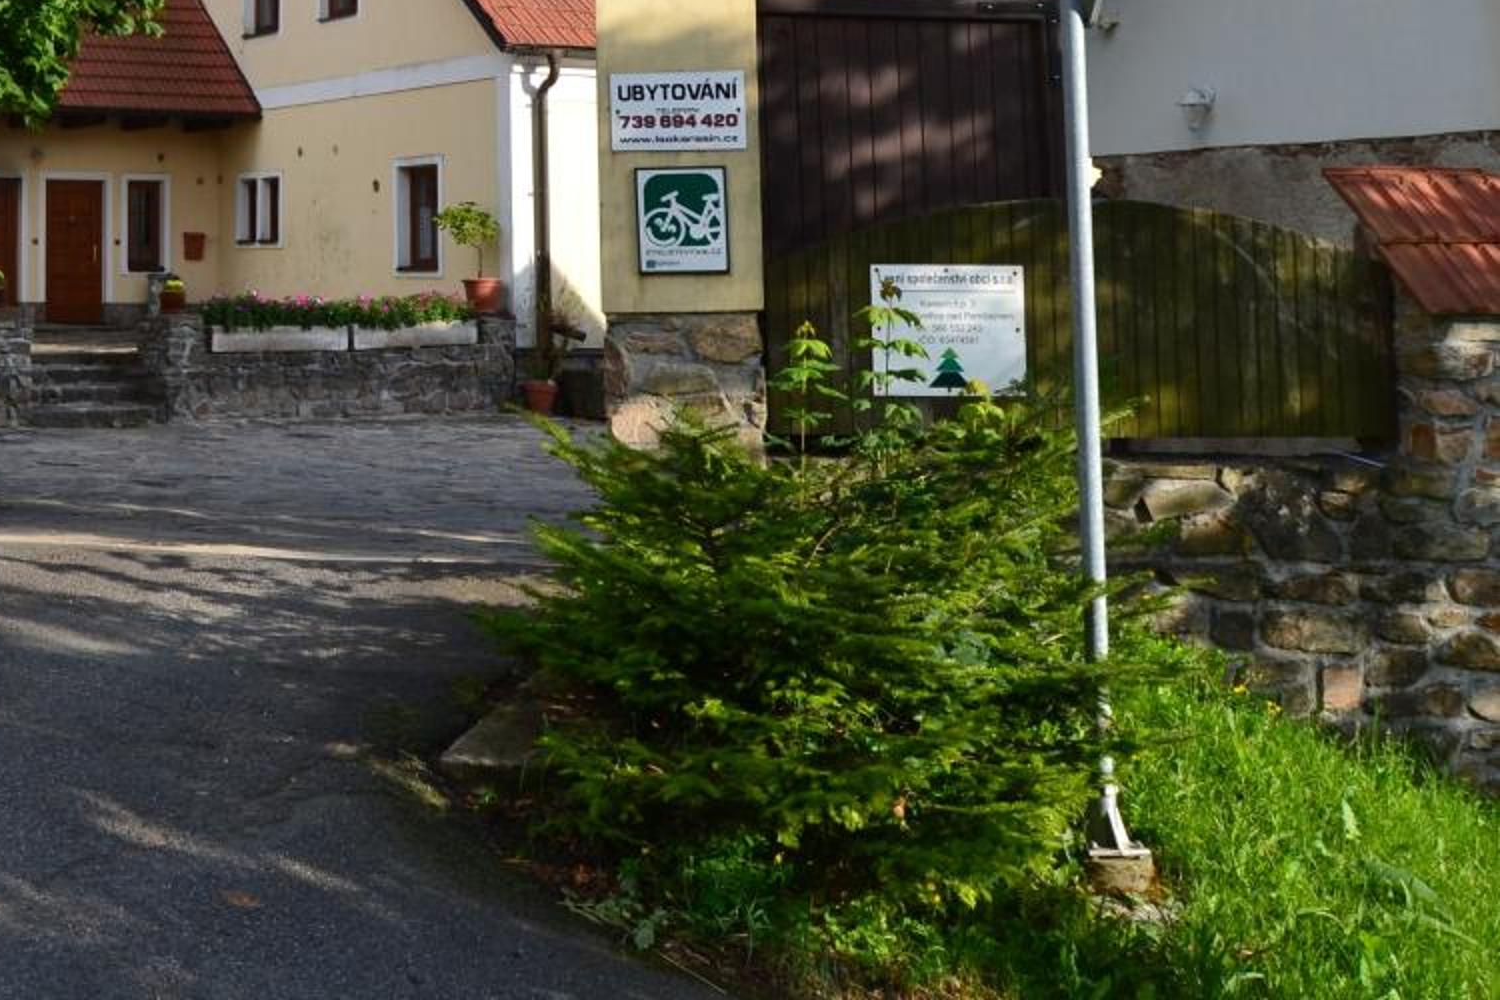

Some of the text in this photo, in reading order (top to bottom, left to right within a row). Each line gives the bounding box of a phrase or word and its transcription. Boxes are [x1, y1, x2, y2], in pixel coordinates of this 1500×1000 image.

[617, 77, 738, 101] UBYTOVÁNÍ
[619, 114, 656, 129] 739
[700, 113, 739, 128] 420
